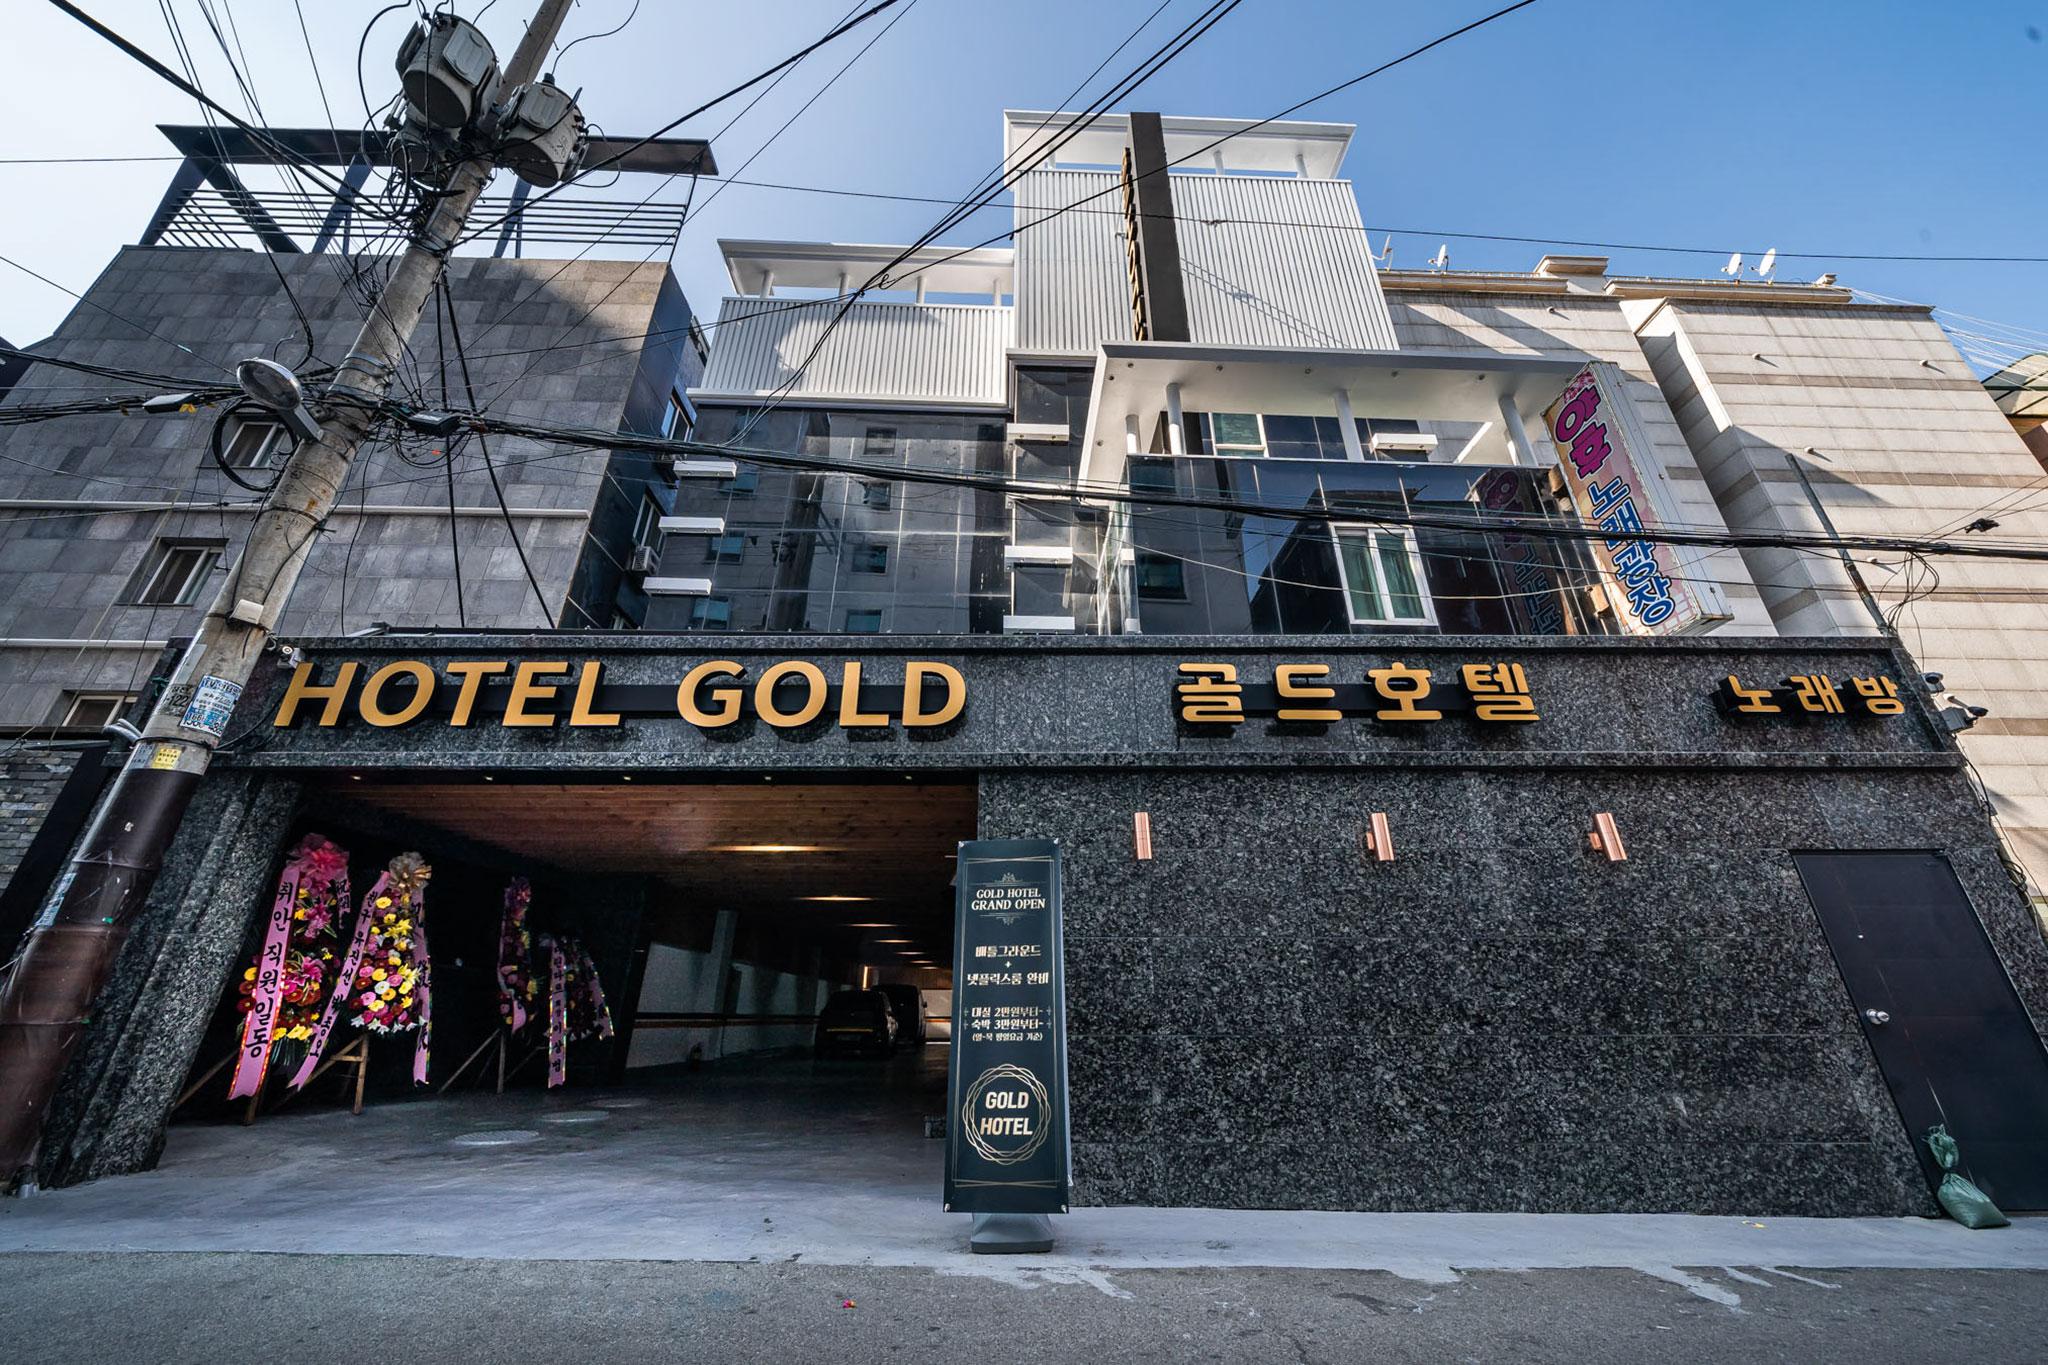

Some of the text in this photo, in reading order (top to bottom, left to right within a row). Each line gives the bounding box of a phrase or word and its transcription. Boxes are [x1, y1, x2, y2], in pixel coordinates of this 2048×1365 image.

[274, 660, 966, 727] HOTEL GOLD
[1179, 661, 1540, 723] 골드호텔
[1728, 674, 1905, 715] 노래방
[976, 888, 1042, 899] GOLD HOTEL
[971, 898, 1046, 911] GRAND OPEN
[975, 945, 1042, 958] 배틀그라운드
[967, 972, 1049, 986] 넷플릭스룸 완비
[971, 1006, 991, 1018] 대실
[971, 1019, 991, 1030] 숙박
[985, 1092, 1029, 1109] GOLD
[980, 1117, 1033, 1136] HOTEL
